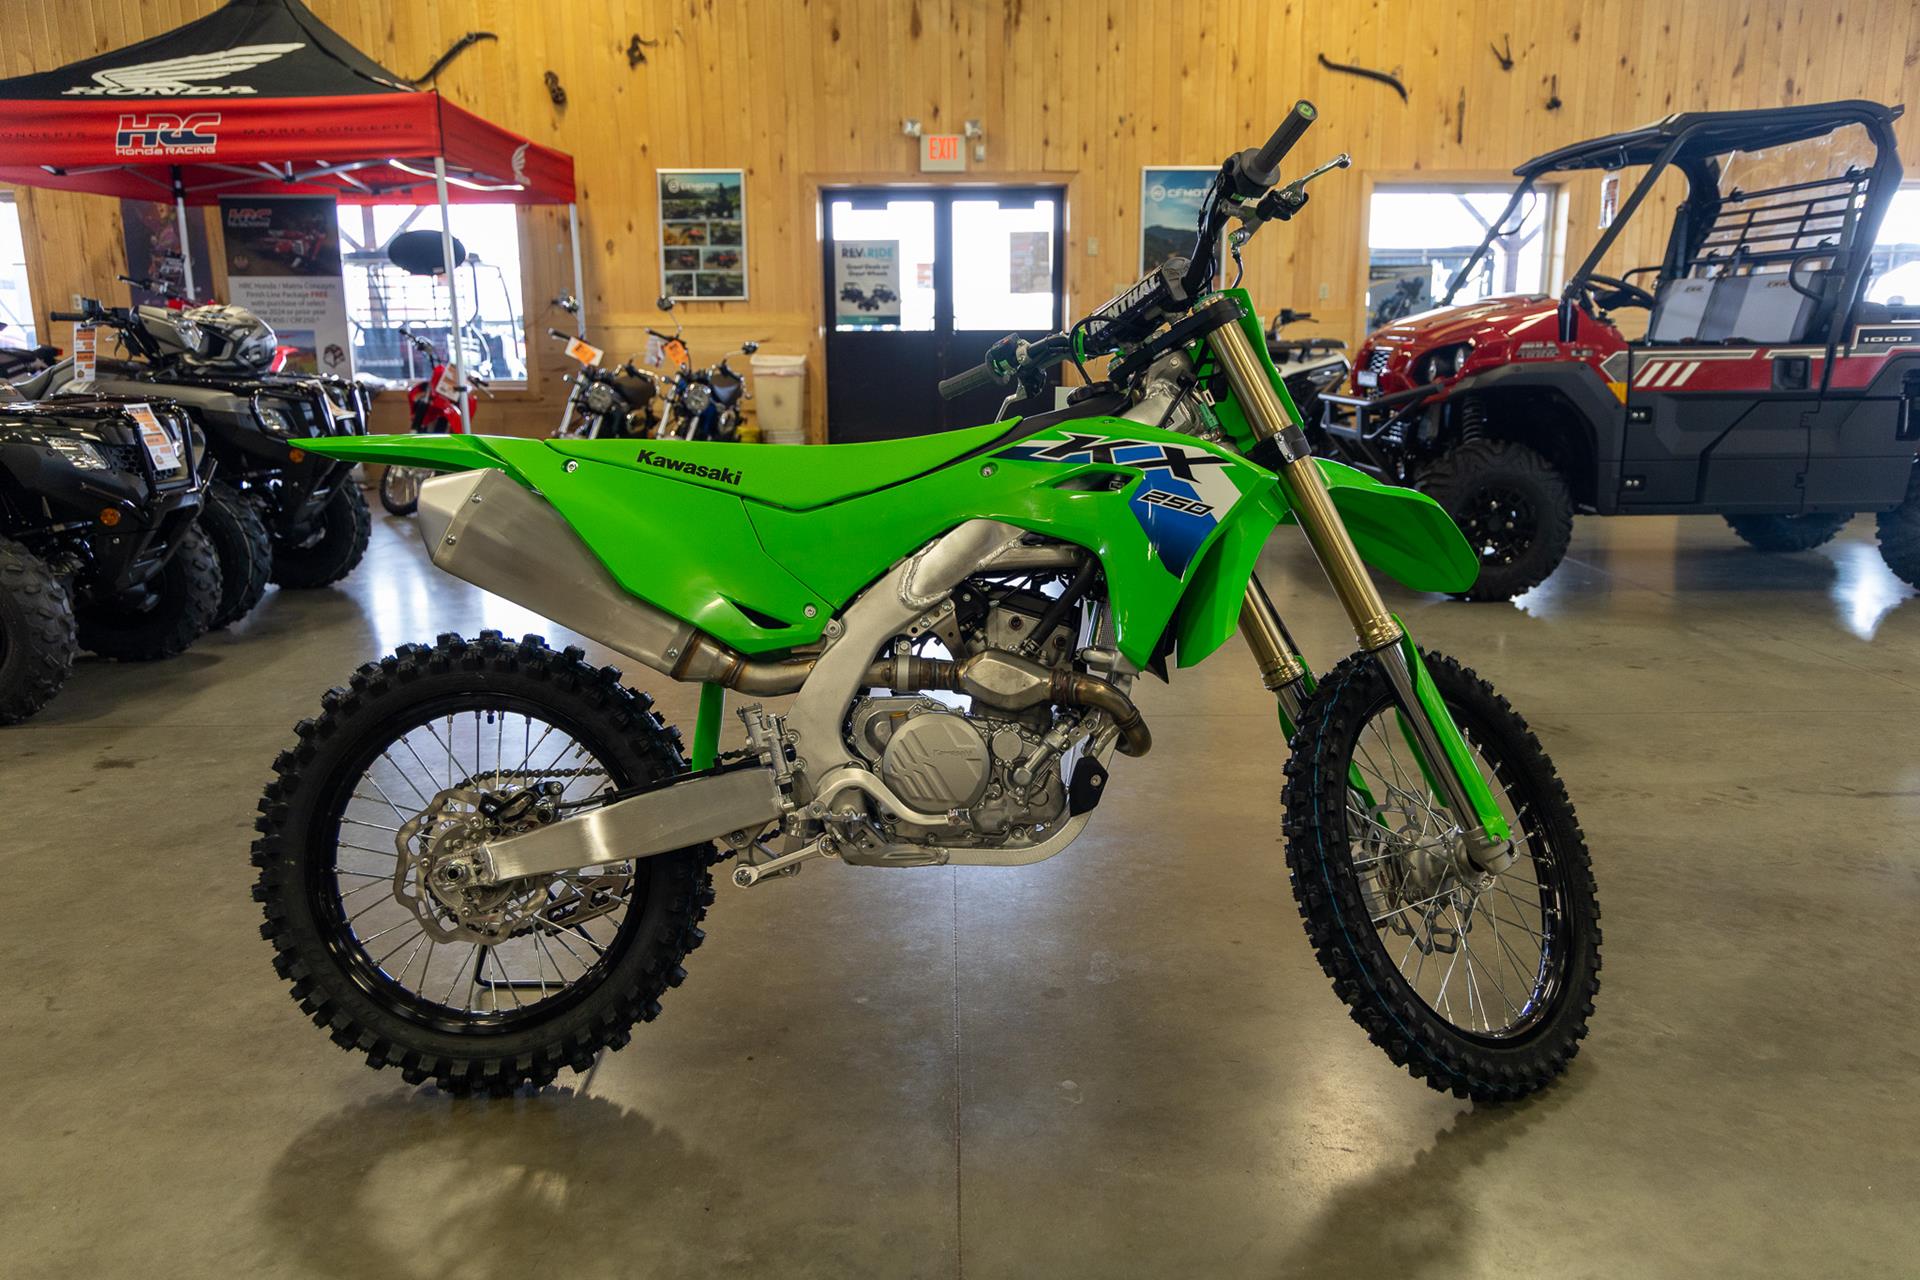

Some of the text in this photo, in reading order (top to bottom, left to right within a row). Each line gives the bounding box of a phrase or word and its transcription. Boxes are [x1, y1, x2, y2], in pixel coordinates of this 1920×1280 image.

[61, 86, 258, 95] HONDA
[116, 113, 221, 148] HRC
[116, 146, 216, 156] Honda RACING
[929, 136, 959, 160] EXIT
[637, 449, 742, 485] Kawasaki
[1138, 489, 1214, 517] 250
